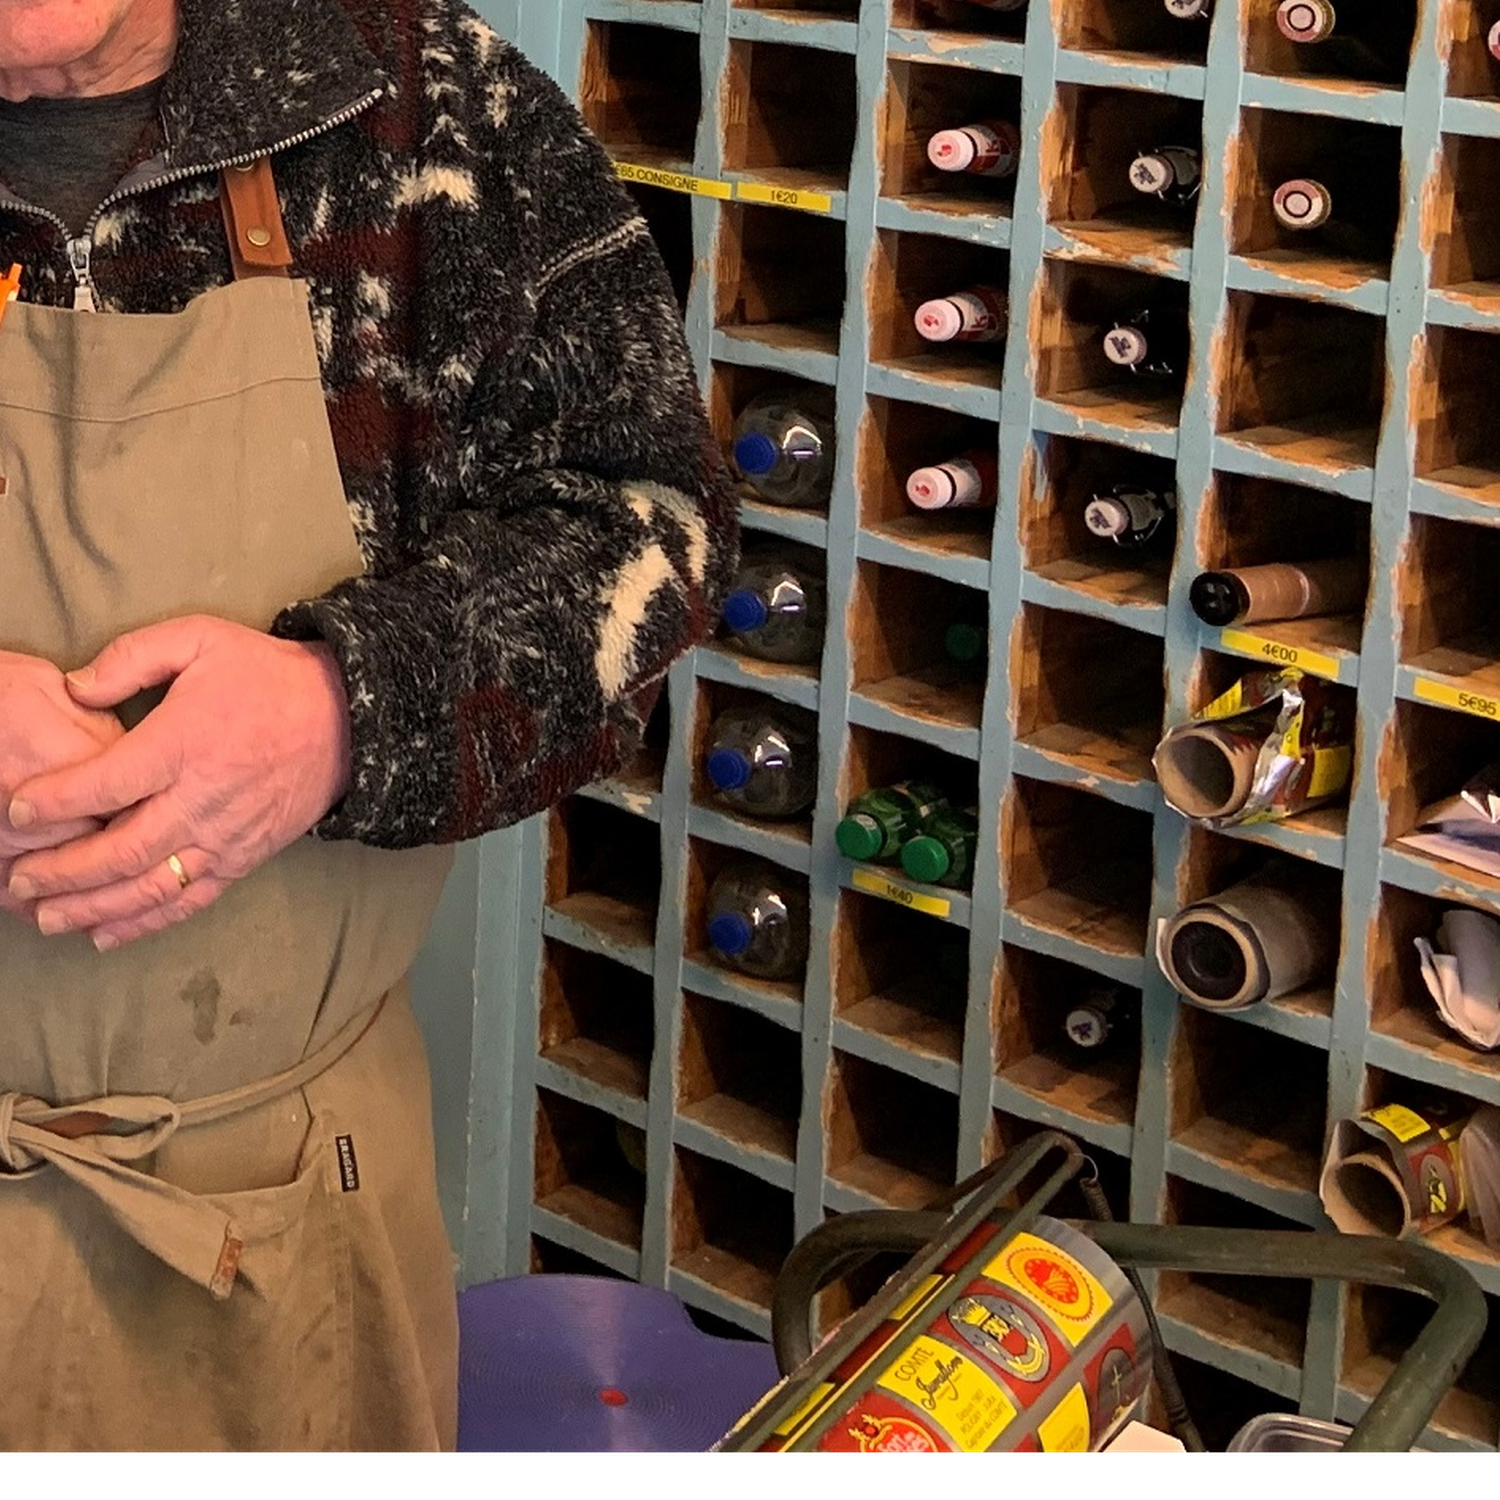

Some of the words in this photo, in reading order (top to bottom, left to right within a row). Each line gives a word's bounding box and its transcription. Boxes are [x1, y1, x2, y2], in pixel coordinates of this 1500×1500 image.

[636, 170, 698, 192] CONSIGNE
[771, 190, 797, 204] 1€20
[1262, 643, 1297, 662] 4€00
[1458, 693, 1496, 716] 5€95
